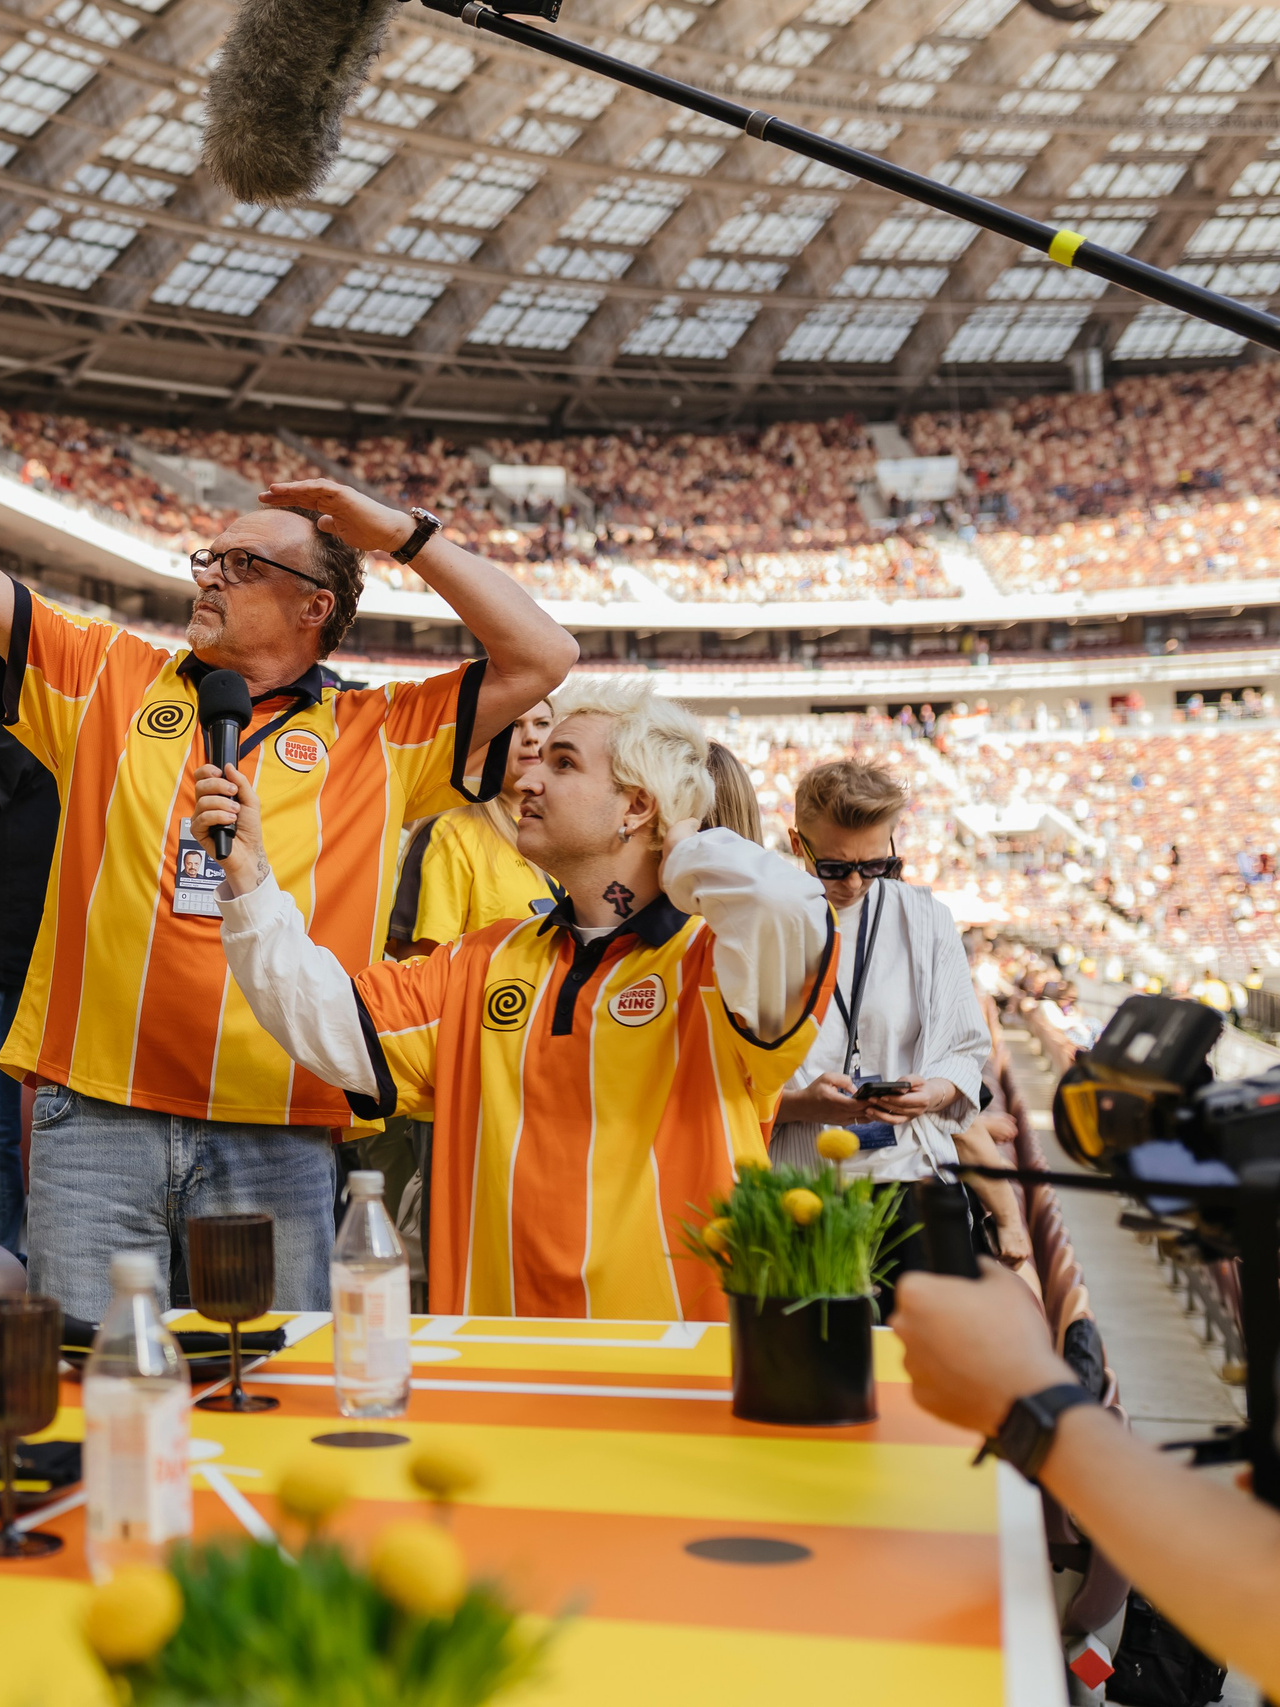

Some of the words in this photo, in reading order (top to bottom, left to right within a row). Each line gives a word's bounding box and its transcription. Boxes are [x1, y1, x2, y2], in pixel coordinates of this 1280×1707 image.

[285, 742, 318, 753] BURGER
[285, 748, 318, 761] KING
[620, 990, 656, 999] BURGER
[618, 998, 655, 1009] KING
